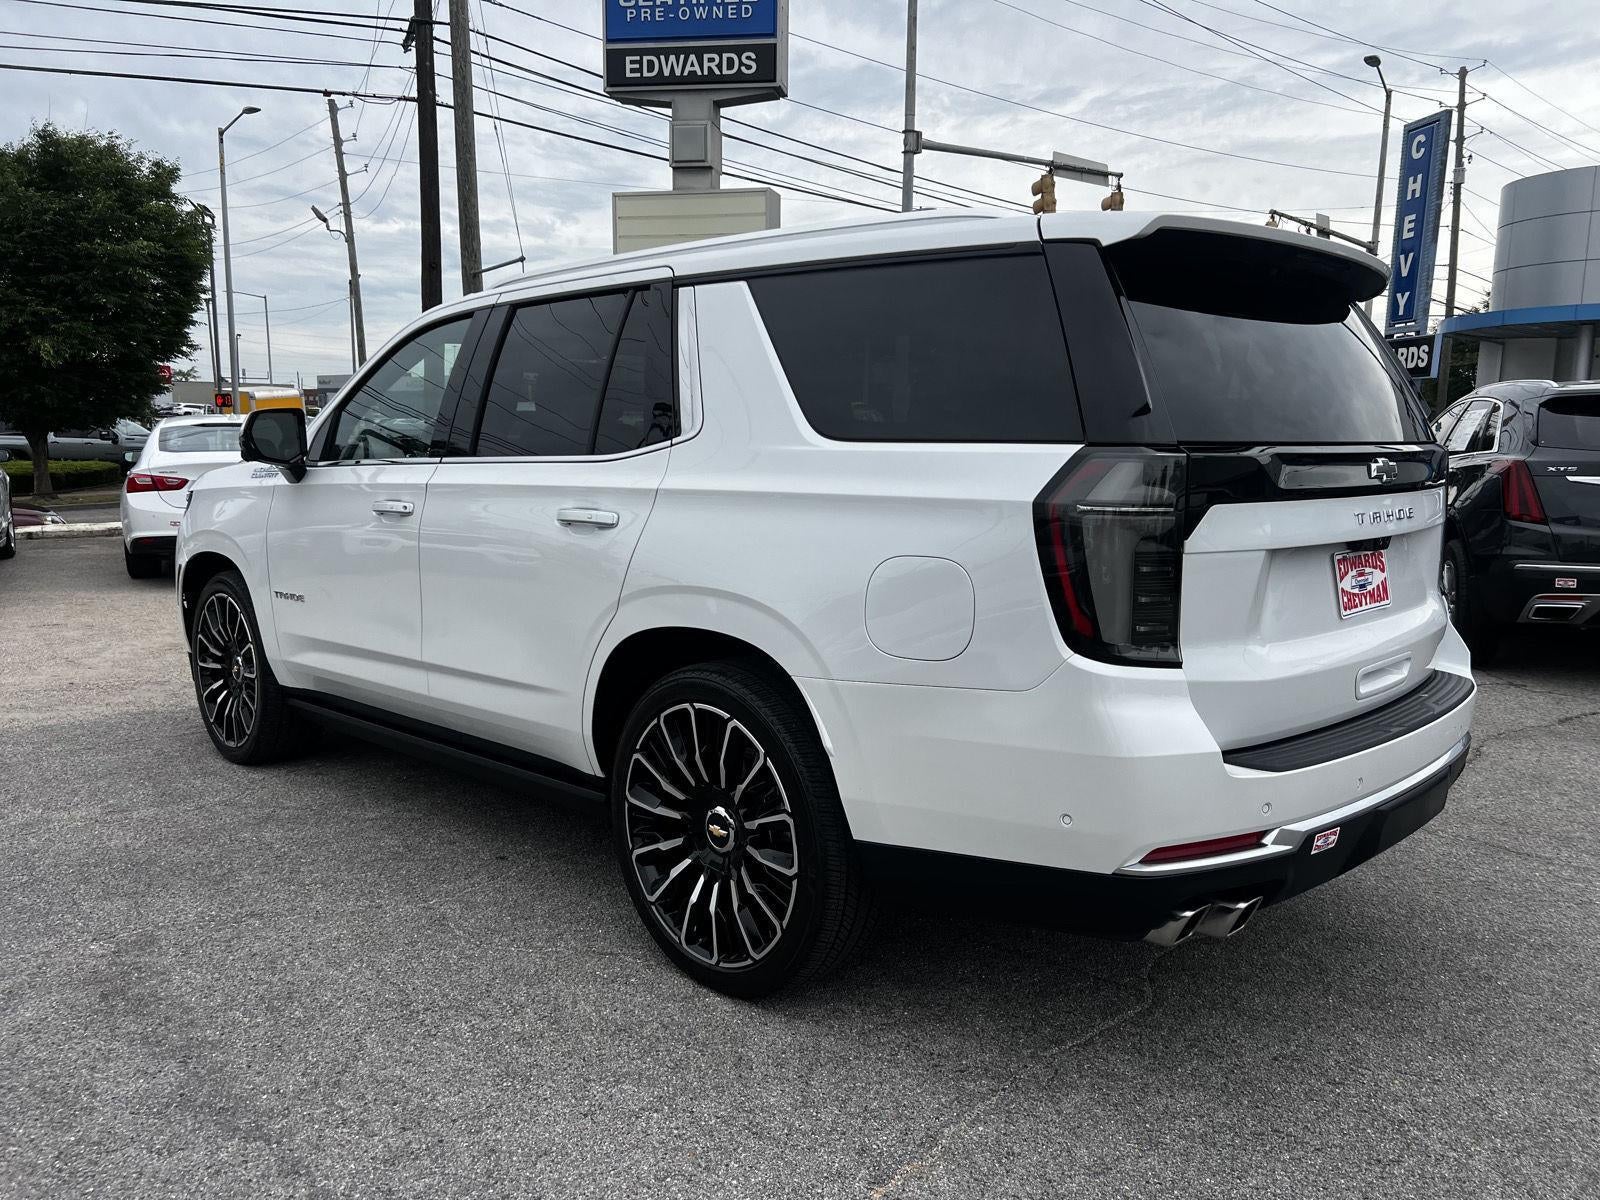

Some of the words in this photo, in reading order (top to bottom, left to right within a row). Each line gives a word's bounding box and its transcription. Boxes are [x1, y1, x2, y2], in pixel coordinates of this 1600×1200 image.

[626, 5, 753, 22] PRE-OWNED
[625, 51, 757, 78] EDWARDS
[1396, 134, 1426, 316] CHEVY
[1393, 345, 1429, 369] RDS
[1354, 507, 1414, 525] TAHOE
[1336, 551, 1386, 581] EDWARDS
[1340, 577, 1389, 612] CHEVYMAN
